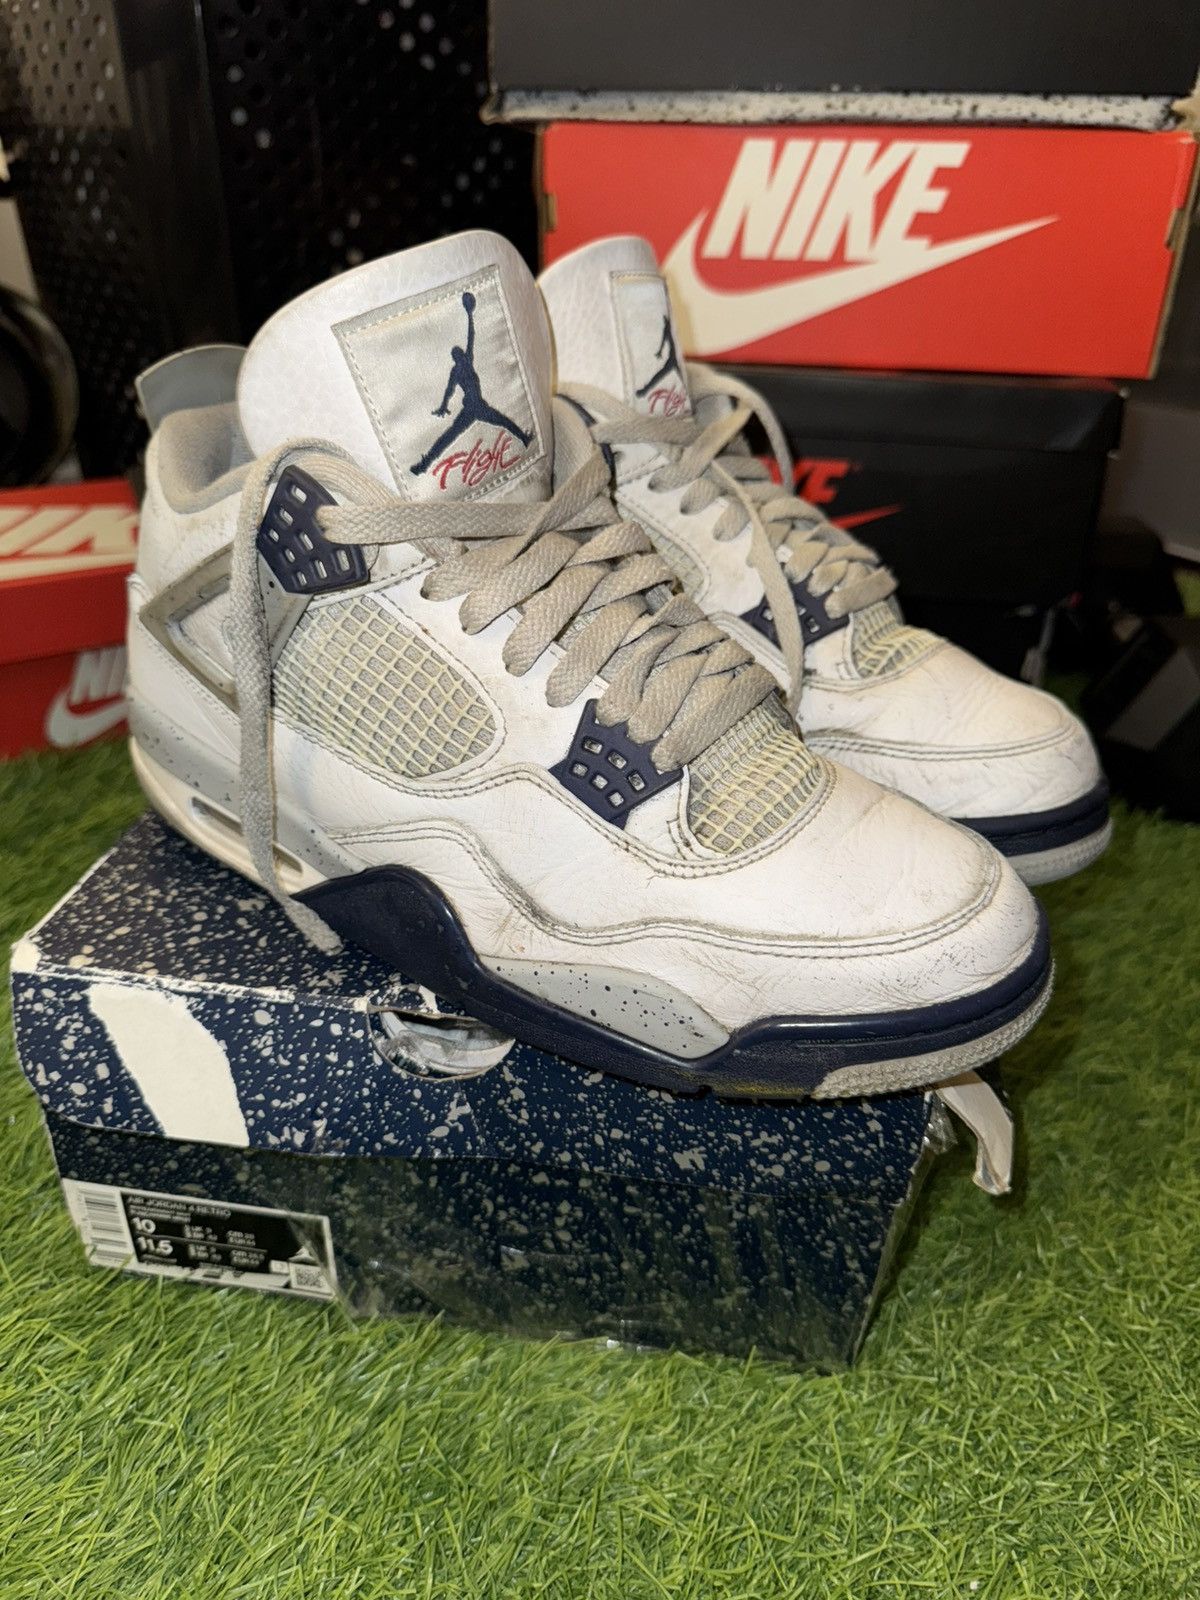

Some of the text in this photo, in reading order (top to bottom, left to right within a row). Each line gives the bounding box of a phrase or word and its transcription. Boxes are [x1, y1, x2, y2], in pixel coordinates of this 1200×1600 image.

[700, 138, 972, 262] NIKE
[431, 430, 521, 490] Flight
[130, 1216, 156, 1234] 10
[137, 1236, 174, 1256] 11.5
